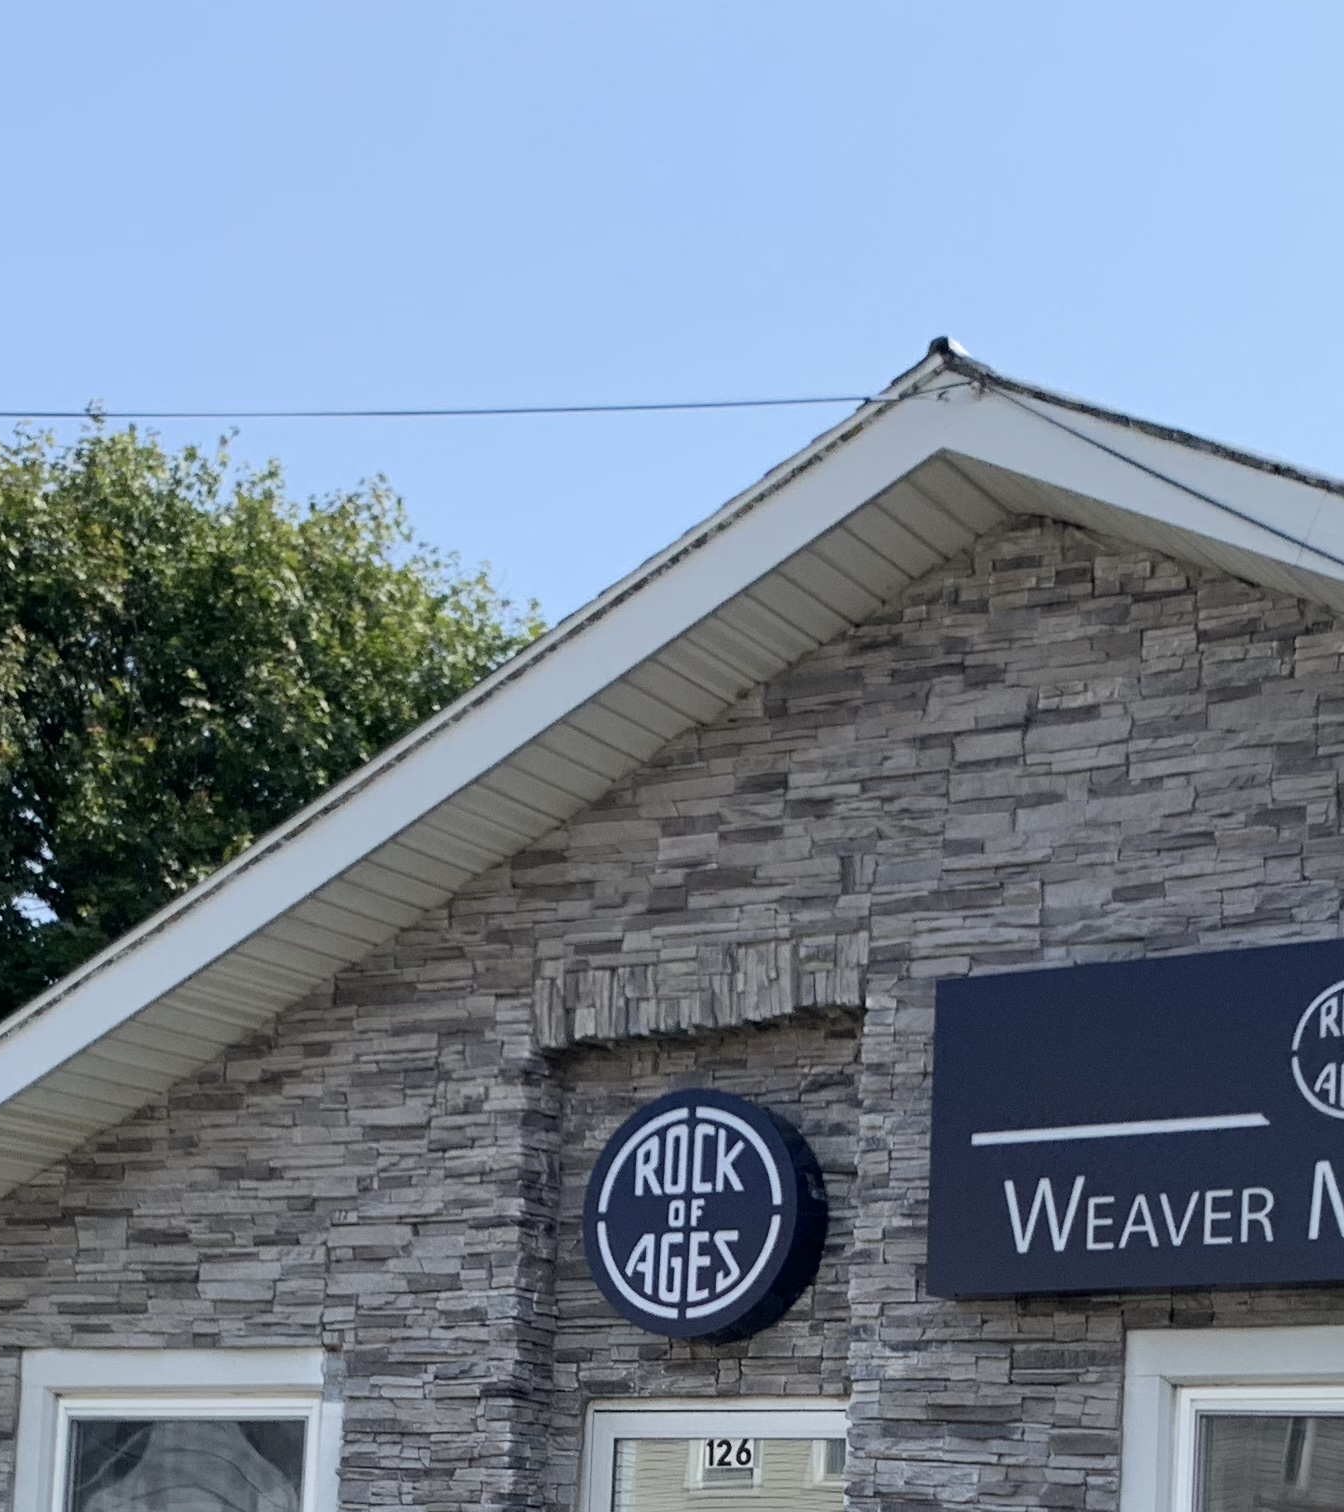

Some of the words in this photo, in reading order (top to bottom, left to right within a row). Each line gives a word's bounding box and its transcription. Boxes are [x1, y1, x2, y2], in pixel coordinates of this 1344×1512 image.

[634, 1123, 745, 1197] ROCK
[668, 1198, 706, 1228] OF
[624, 1229, 741, 1303] AGES
[706, 1438, 752, 1467] 126
